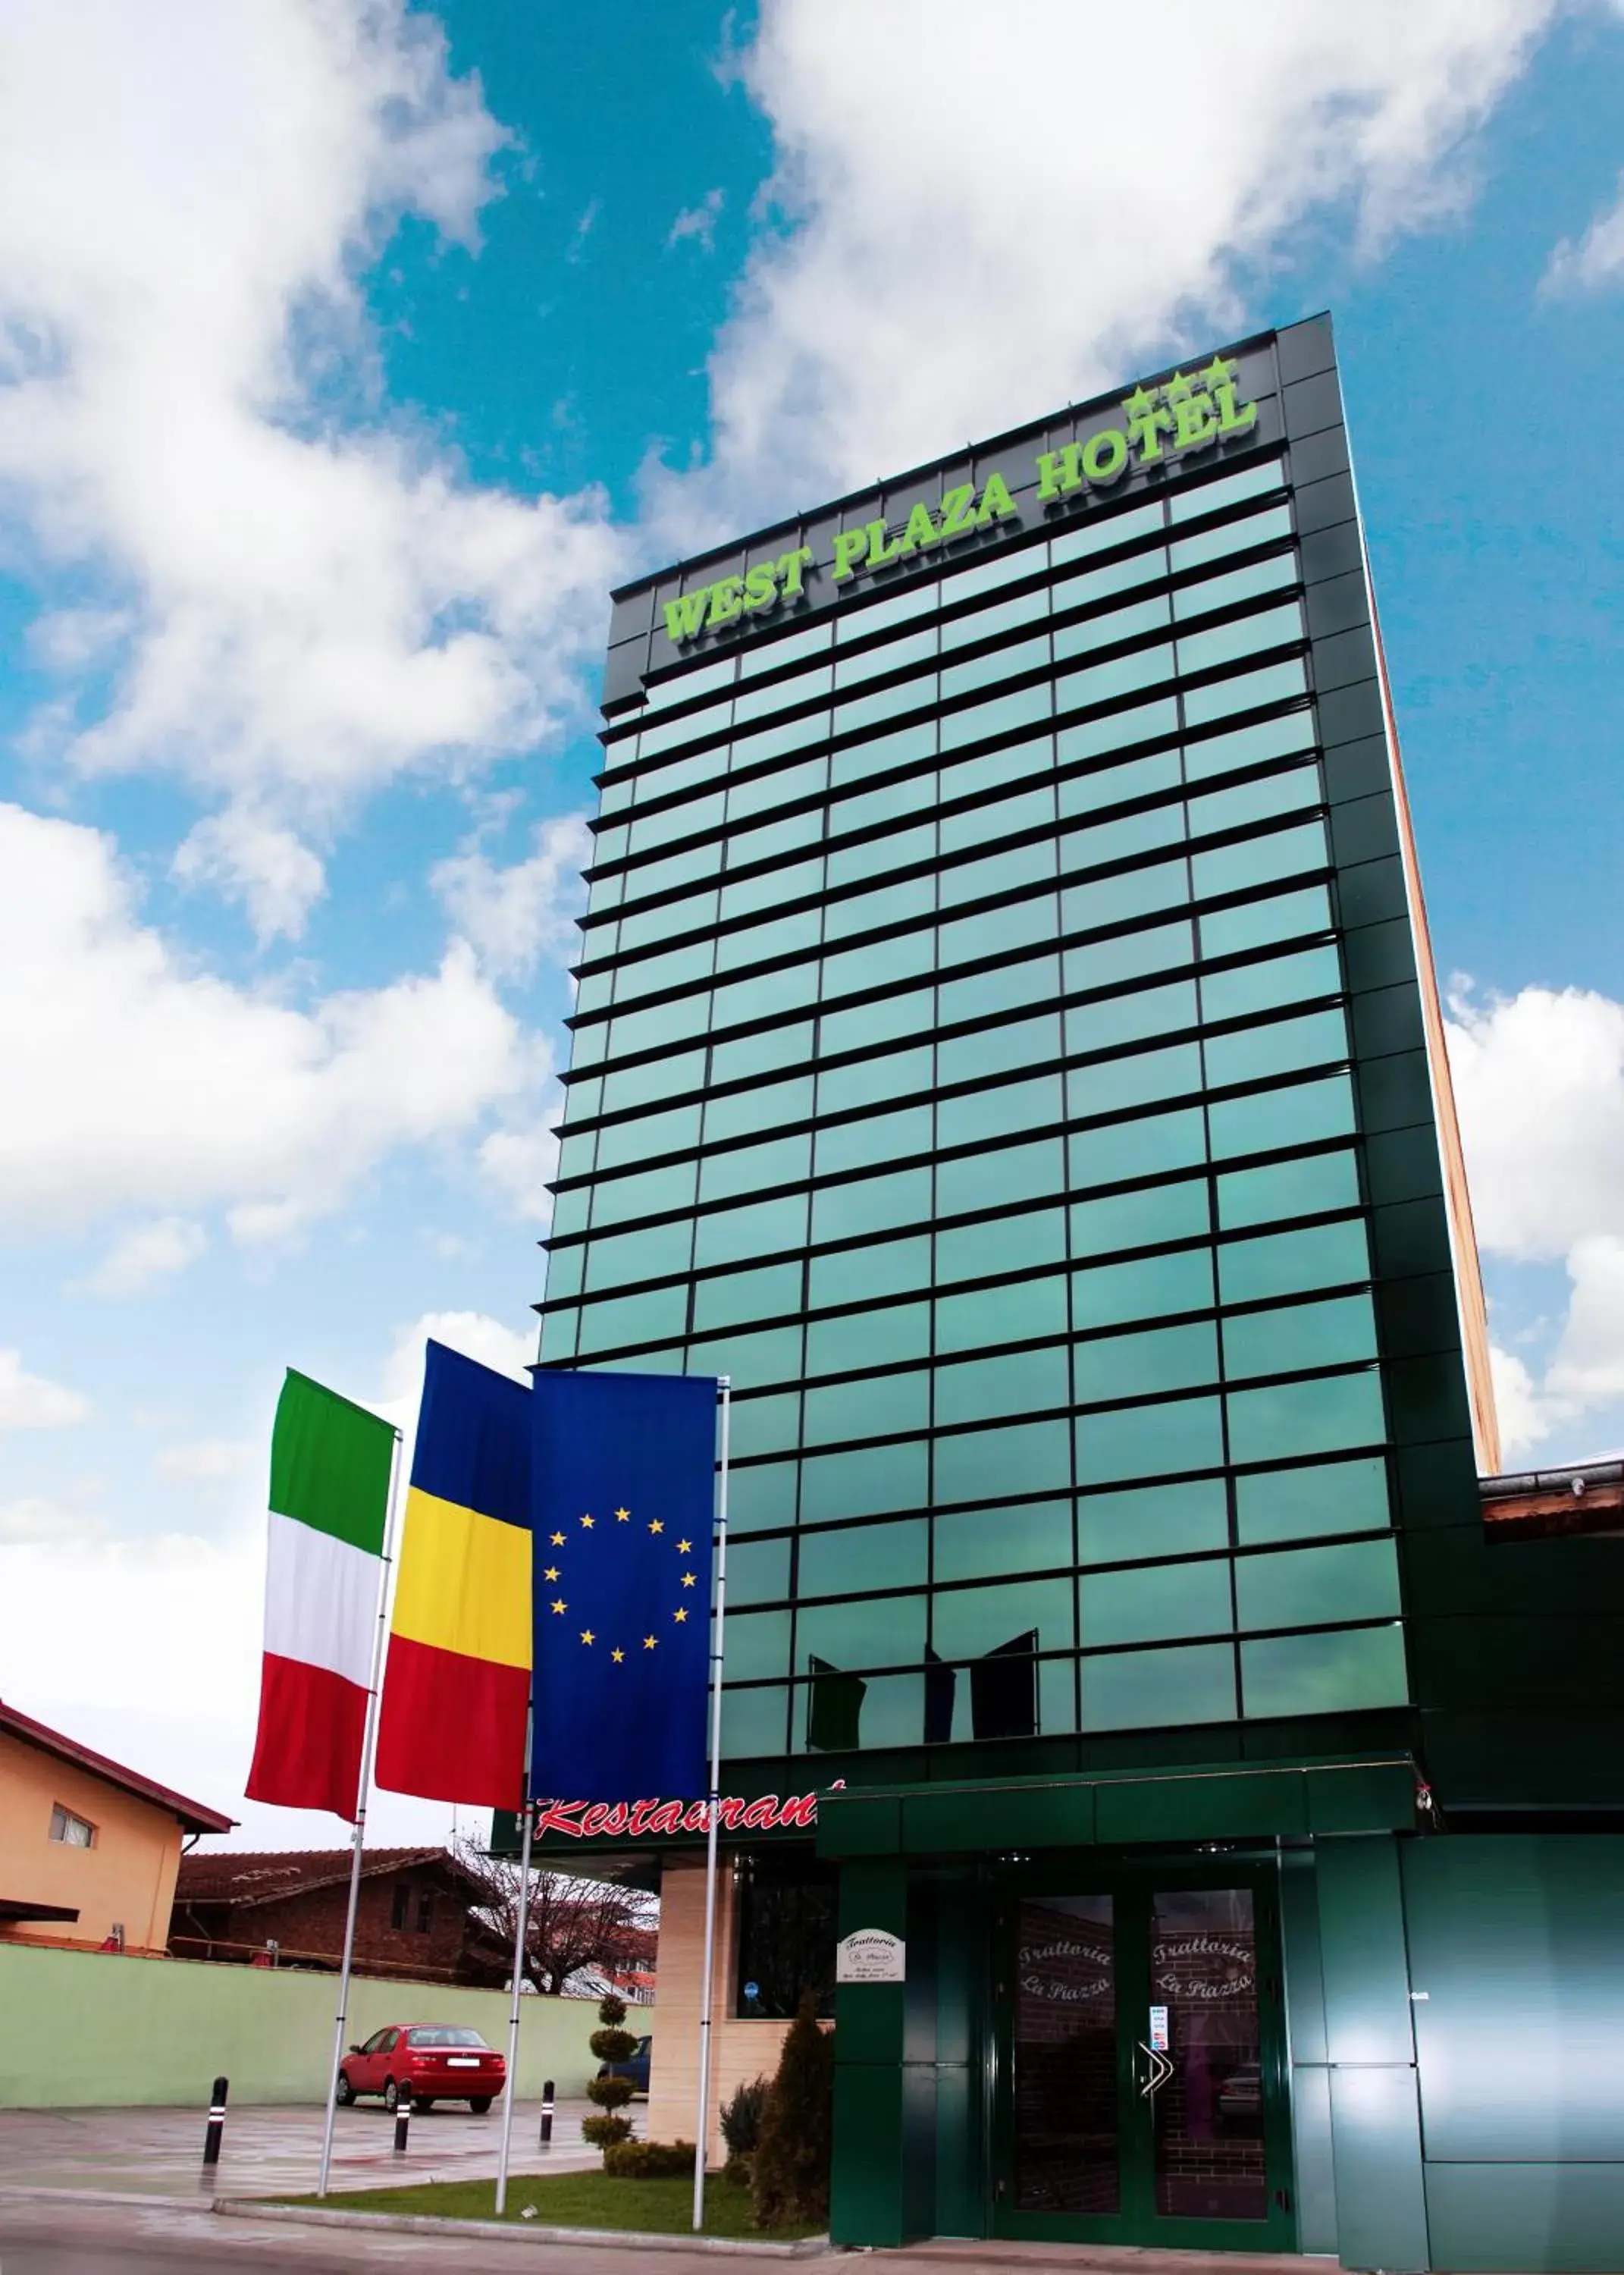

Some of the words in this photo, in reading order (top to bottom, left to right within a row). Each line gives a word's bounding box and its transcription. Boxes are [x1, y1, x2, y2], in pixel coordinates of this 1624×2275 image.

[663, 547, 811, 642] WEST
[832, 474, 1017, 580] PLAZA
[1036, 383, 1258, 501] HOTEL
[533, 1779, 847, 1840] Restauran
[1017, 1941, 1111, 1966] Trattoria
[1152, 1938, 1251, 1965] Trattoria
[1020, 1975, 1043, 1996] La
[1047, 1978, 1110, 2000] Piazza
[1155, 1973, 1182, 1994] La
[1185, 1975, 1252, 1998] Piazza
